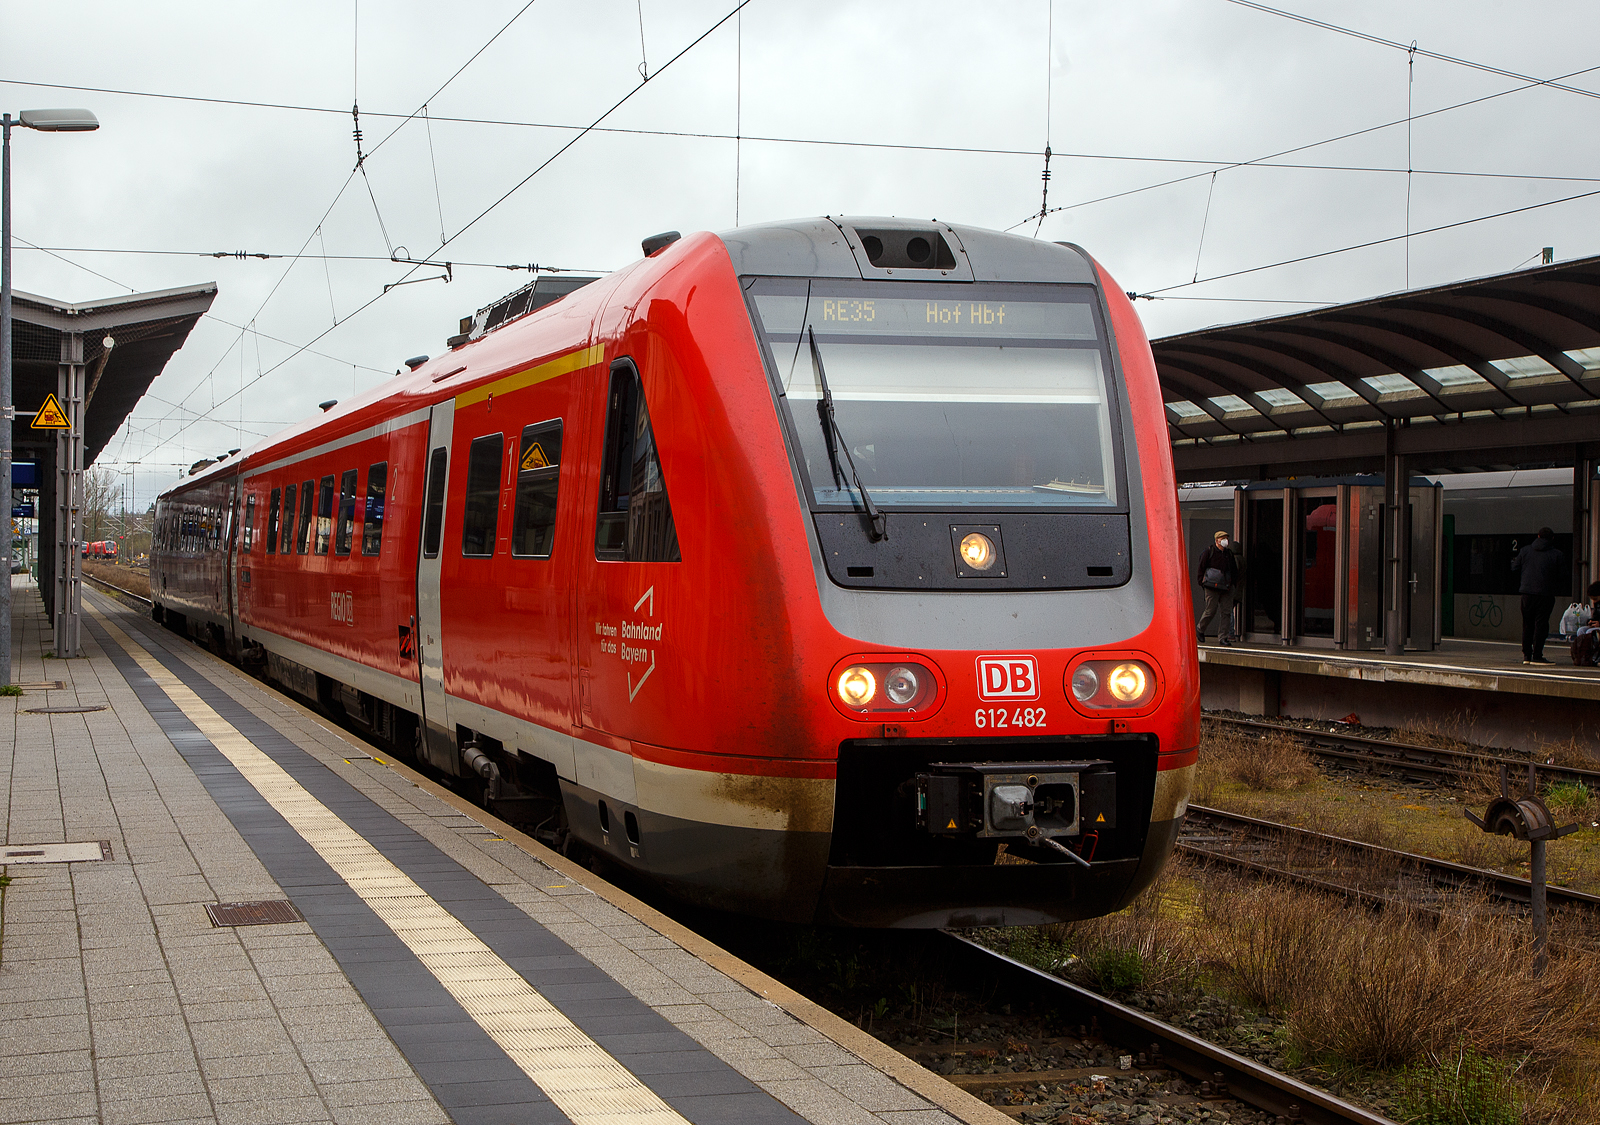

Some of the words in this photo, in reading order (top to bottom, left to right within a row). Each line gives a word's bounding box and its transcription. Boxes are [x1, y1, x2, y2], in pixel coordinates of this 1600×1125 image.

[823, 300, 876, 322] RE35
[926, 302, 961, 324] Hof
[970, 303, 1005, 325] Hbf
[1511, 539, 1518, 551] 2
[621, 620, 663, 641] Bahnland
[607, 640, 617, 654] das
[621, 642, 648, 665] Bayern
[984, 663, 1032, 693] DB
[975, 708, 1008, 728] 612
[1011, 707, 1047, 728] 482
